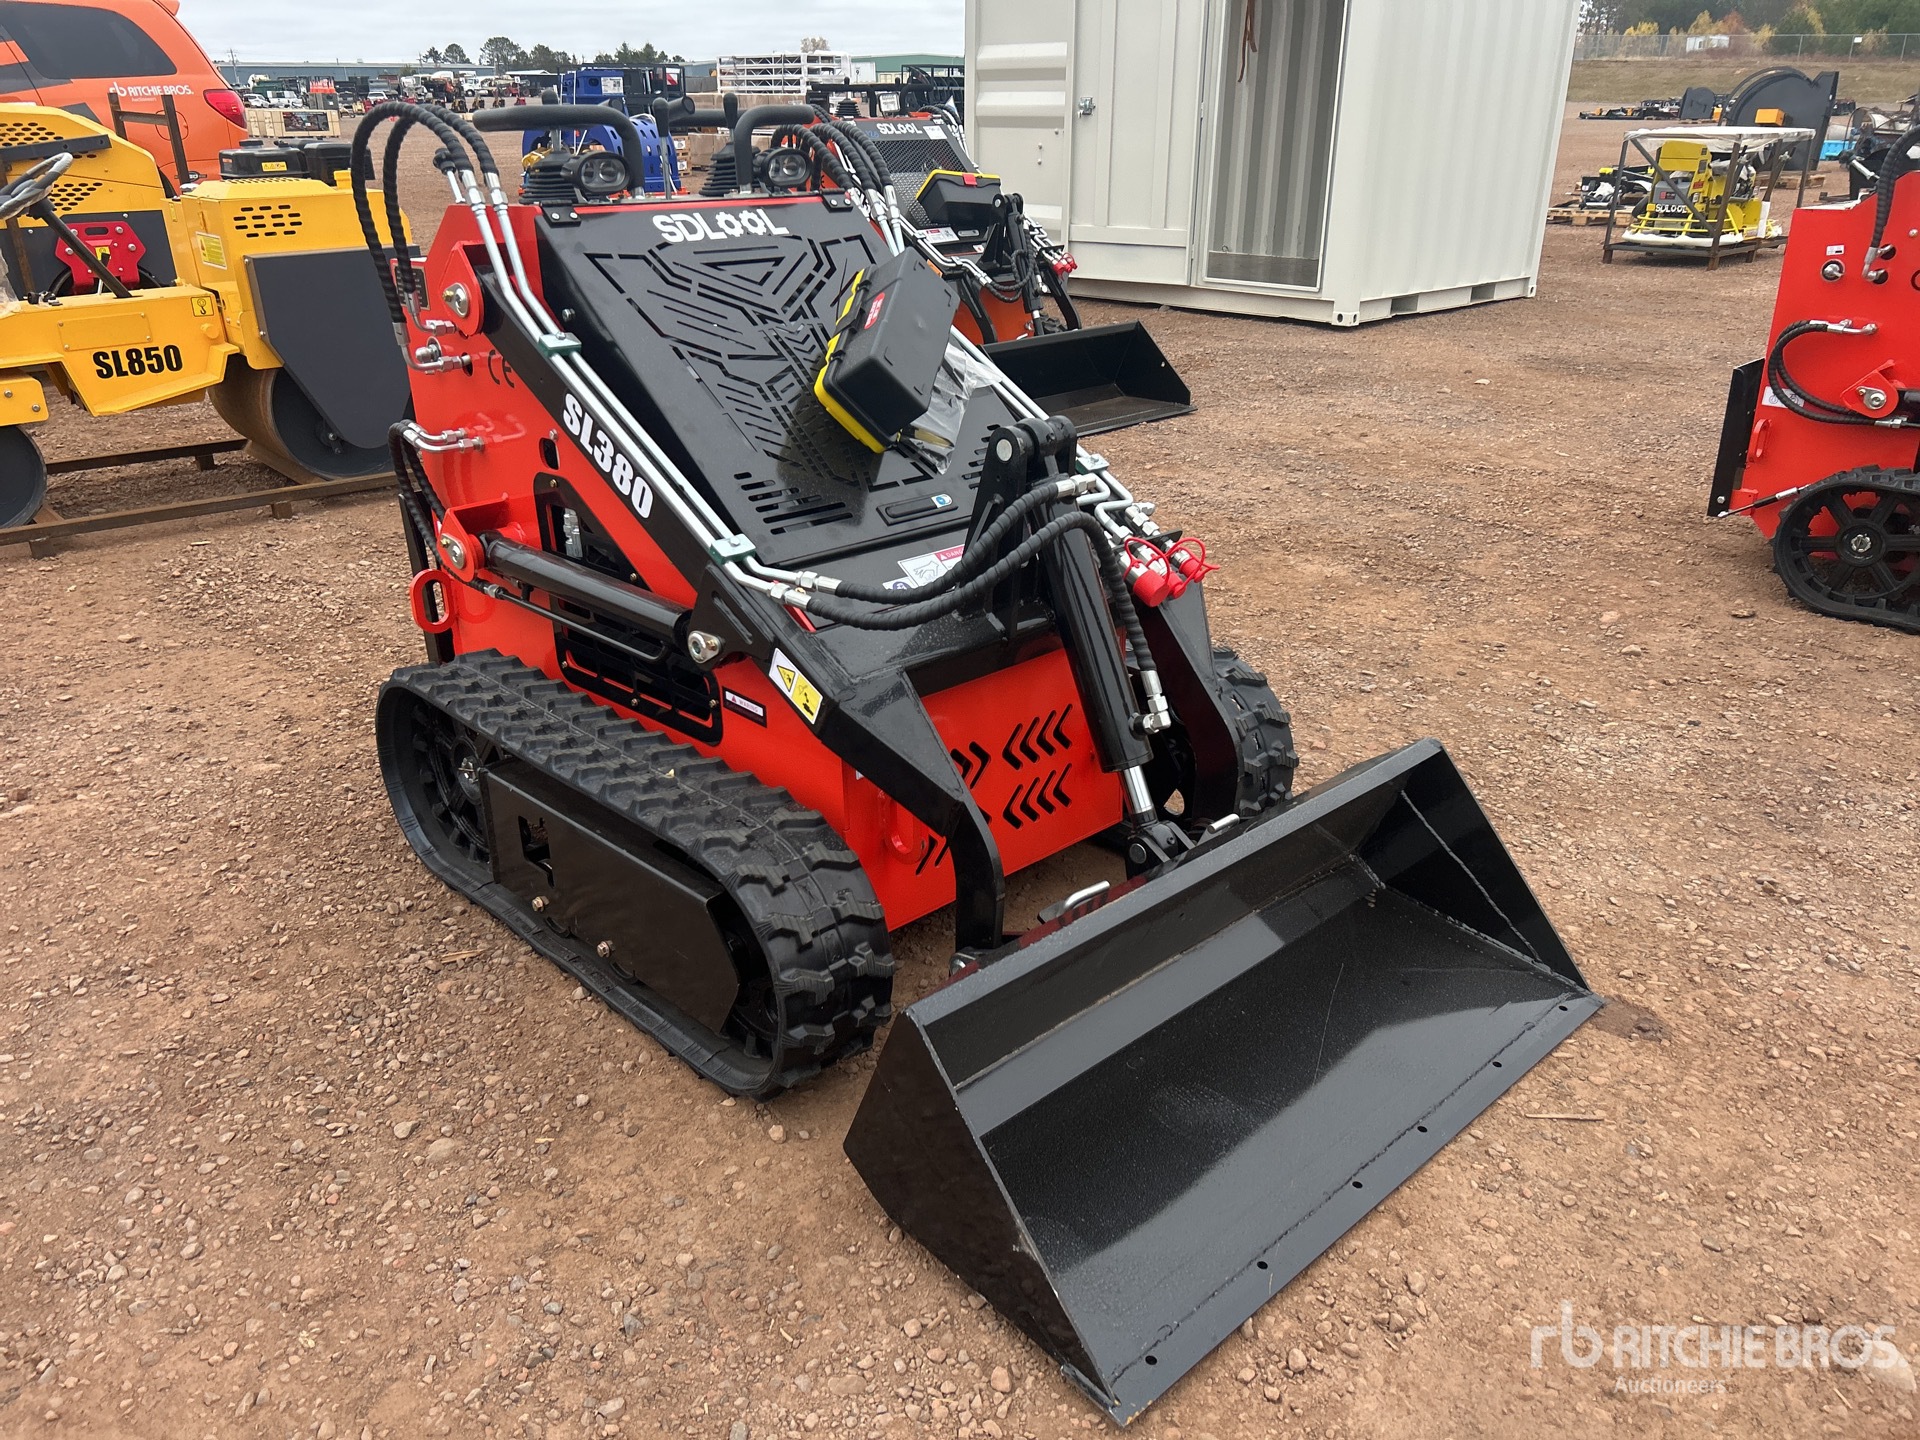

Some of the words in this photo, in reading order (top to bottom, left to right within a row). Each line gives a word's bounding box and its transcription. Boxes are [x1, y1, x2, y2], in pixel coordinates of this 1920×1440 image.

[127, 85, 163, 97] RITCHIE
[163, 85, 195, 95] BROS.
[876, 122, 923, 134] SDLOOL
[652, 208, 790, 243] SDLOOL
[92, 344, 183, 379] SL850
[488, 349, 515, 389] CE
[563, 393, 654, 519] SL380
